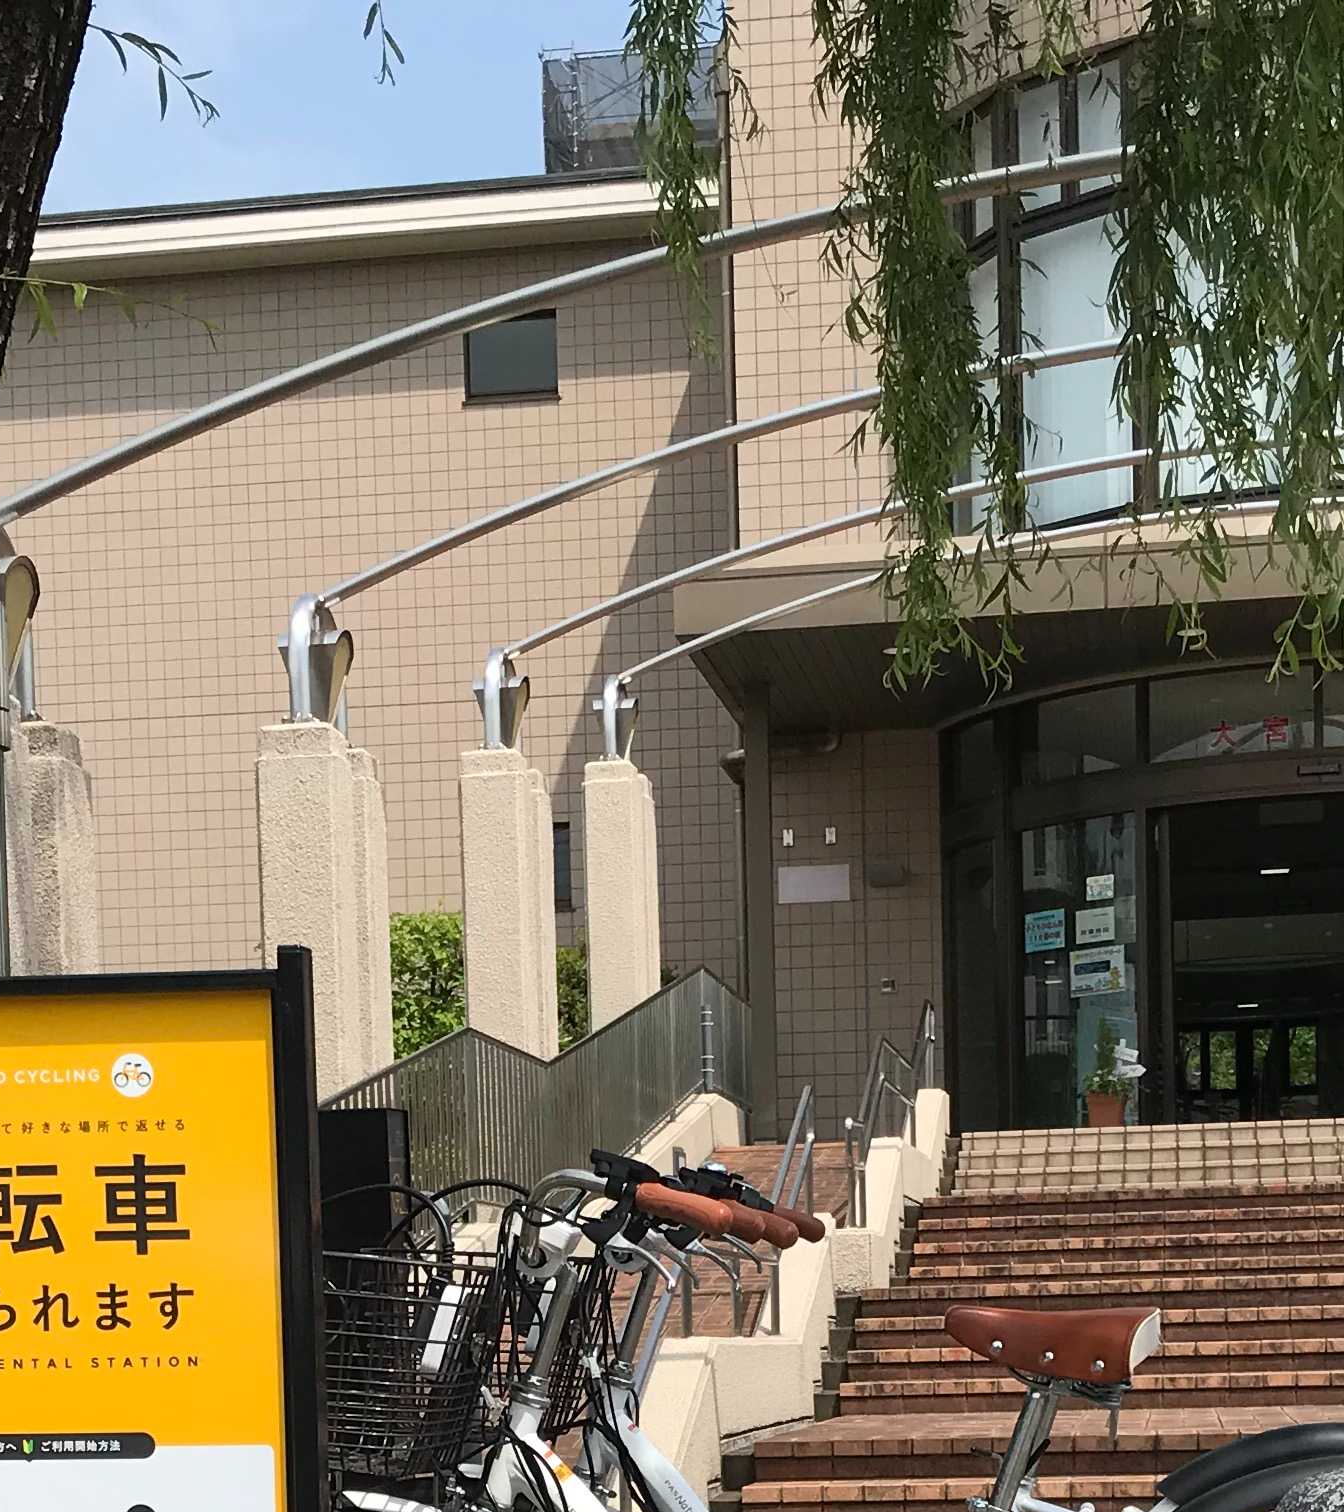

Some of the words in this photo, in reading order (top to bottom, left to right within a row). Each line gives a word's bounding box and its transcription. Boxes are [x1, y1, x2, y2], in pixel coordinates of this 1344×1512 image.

[13, 1068, 101, 1085] CYCLING
[91, 1356, 200, 1369] STATION
[40, 1439, 121, 1453] ご利用開始方法
